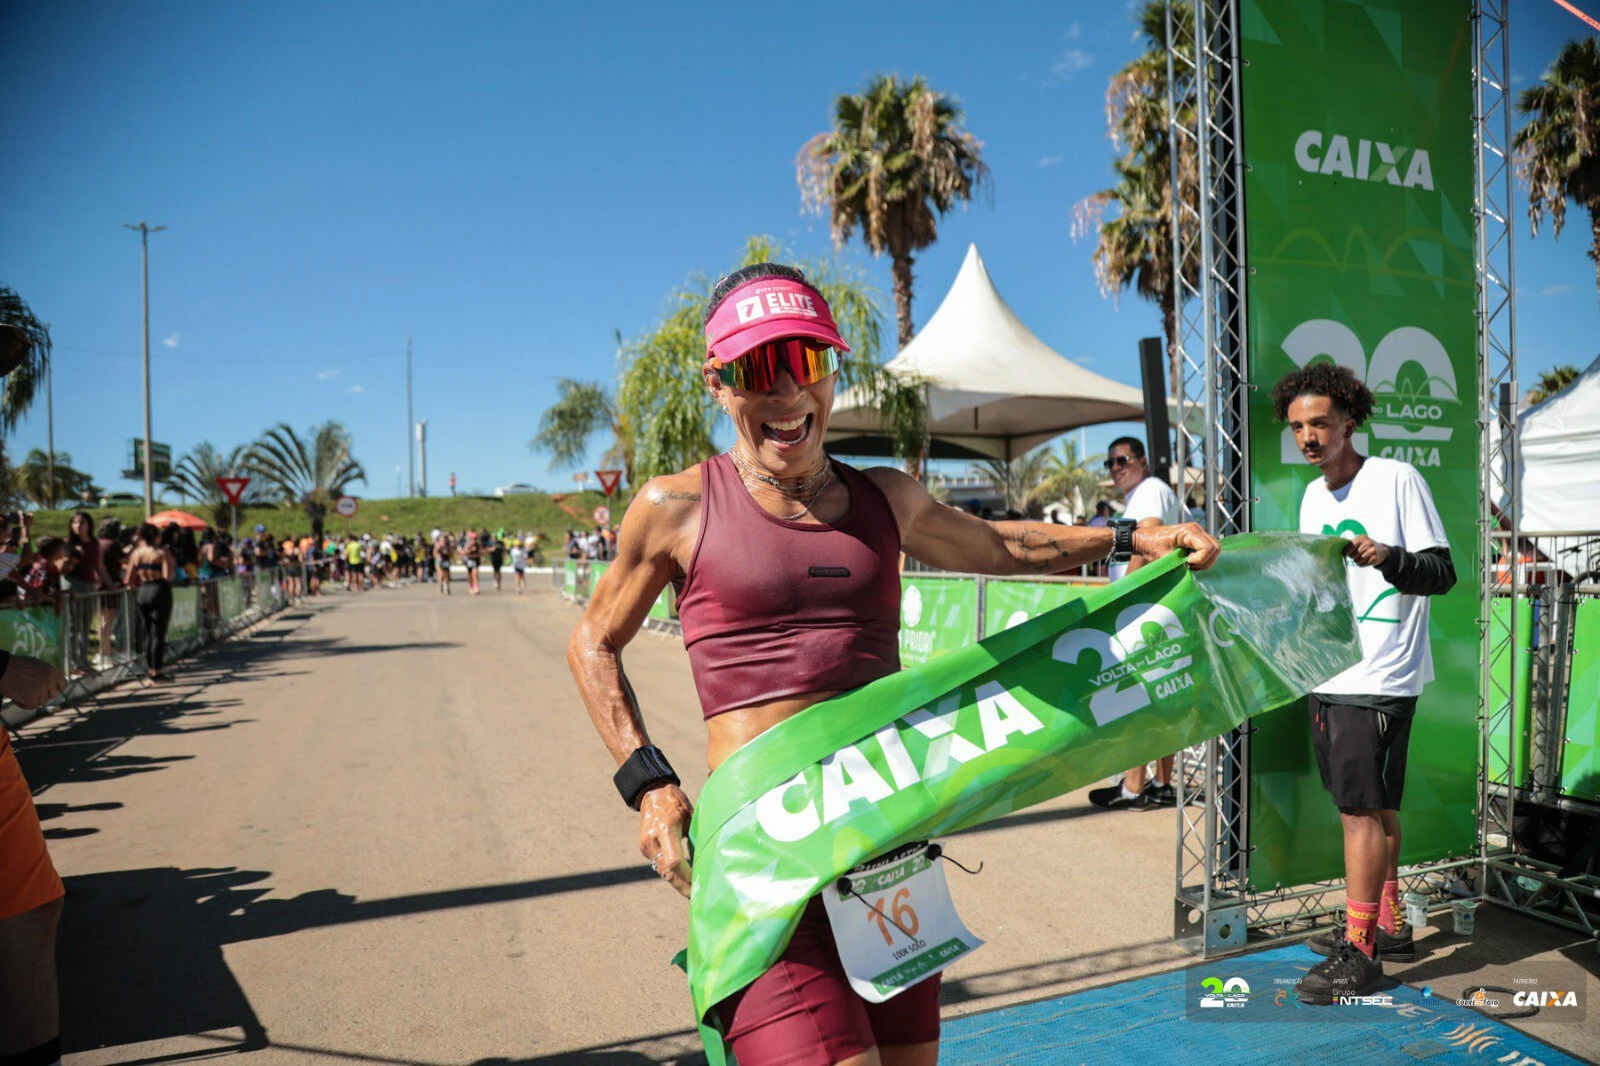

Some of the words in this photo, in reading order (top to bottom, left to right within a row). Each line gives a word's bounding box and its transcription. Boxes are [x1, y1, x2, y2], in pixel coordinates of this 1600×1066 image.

[1294, 130, 1435, 191] CAIXA
[766, 293, 815, 310] ELITE
[1387, 403, 1442, 420] LAGO
[1052, 603, 1192, 728] 20
[1088, 662, 1137, 687] VOLTA
[1145, 643, 1182, 665] LAGO
[1155, 672, 1195, 699] CAIXA
[756, 680, 1045, 842] CAIXA
[867, 887, 920, 947] 16
[892, 949, 909, 960] 100K
[908, 940, 926, 952] SOLO
